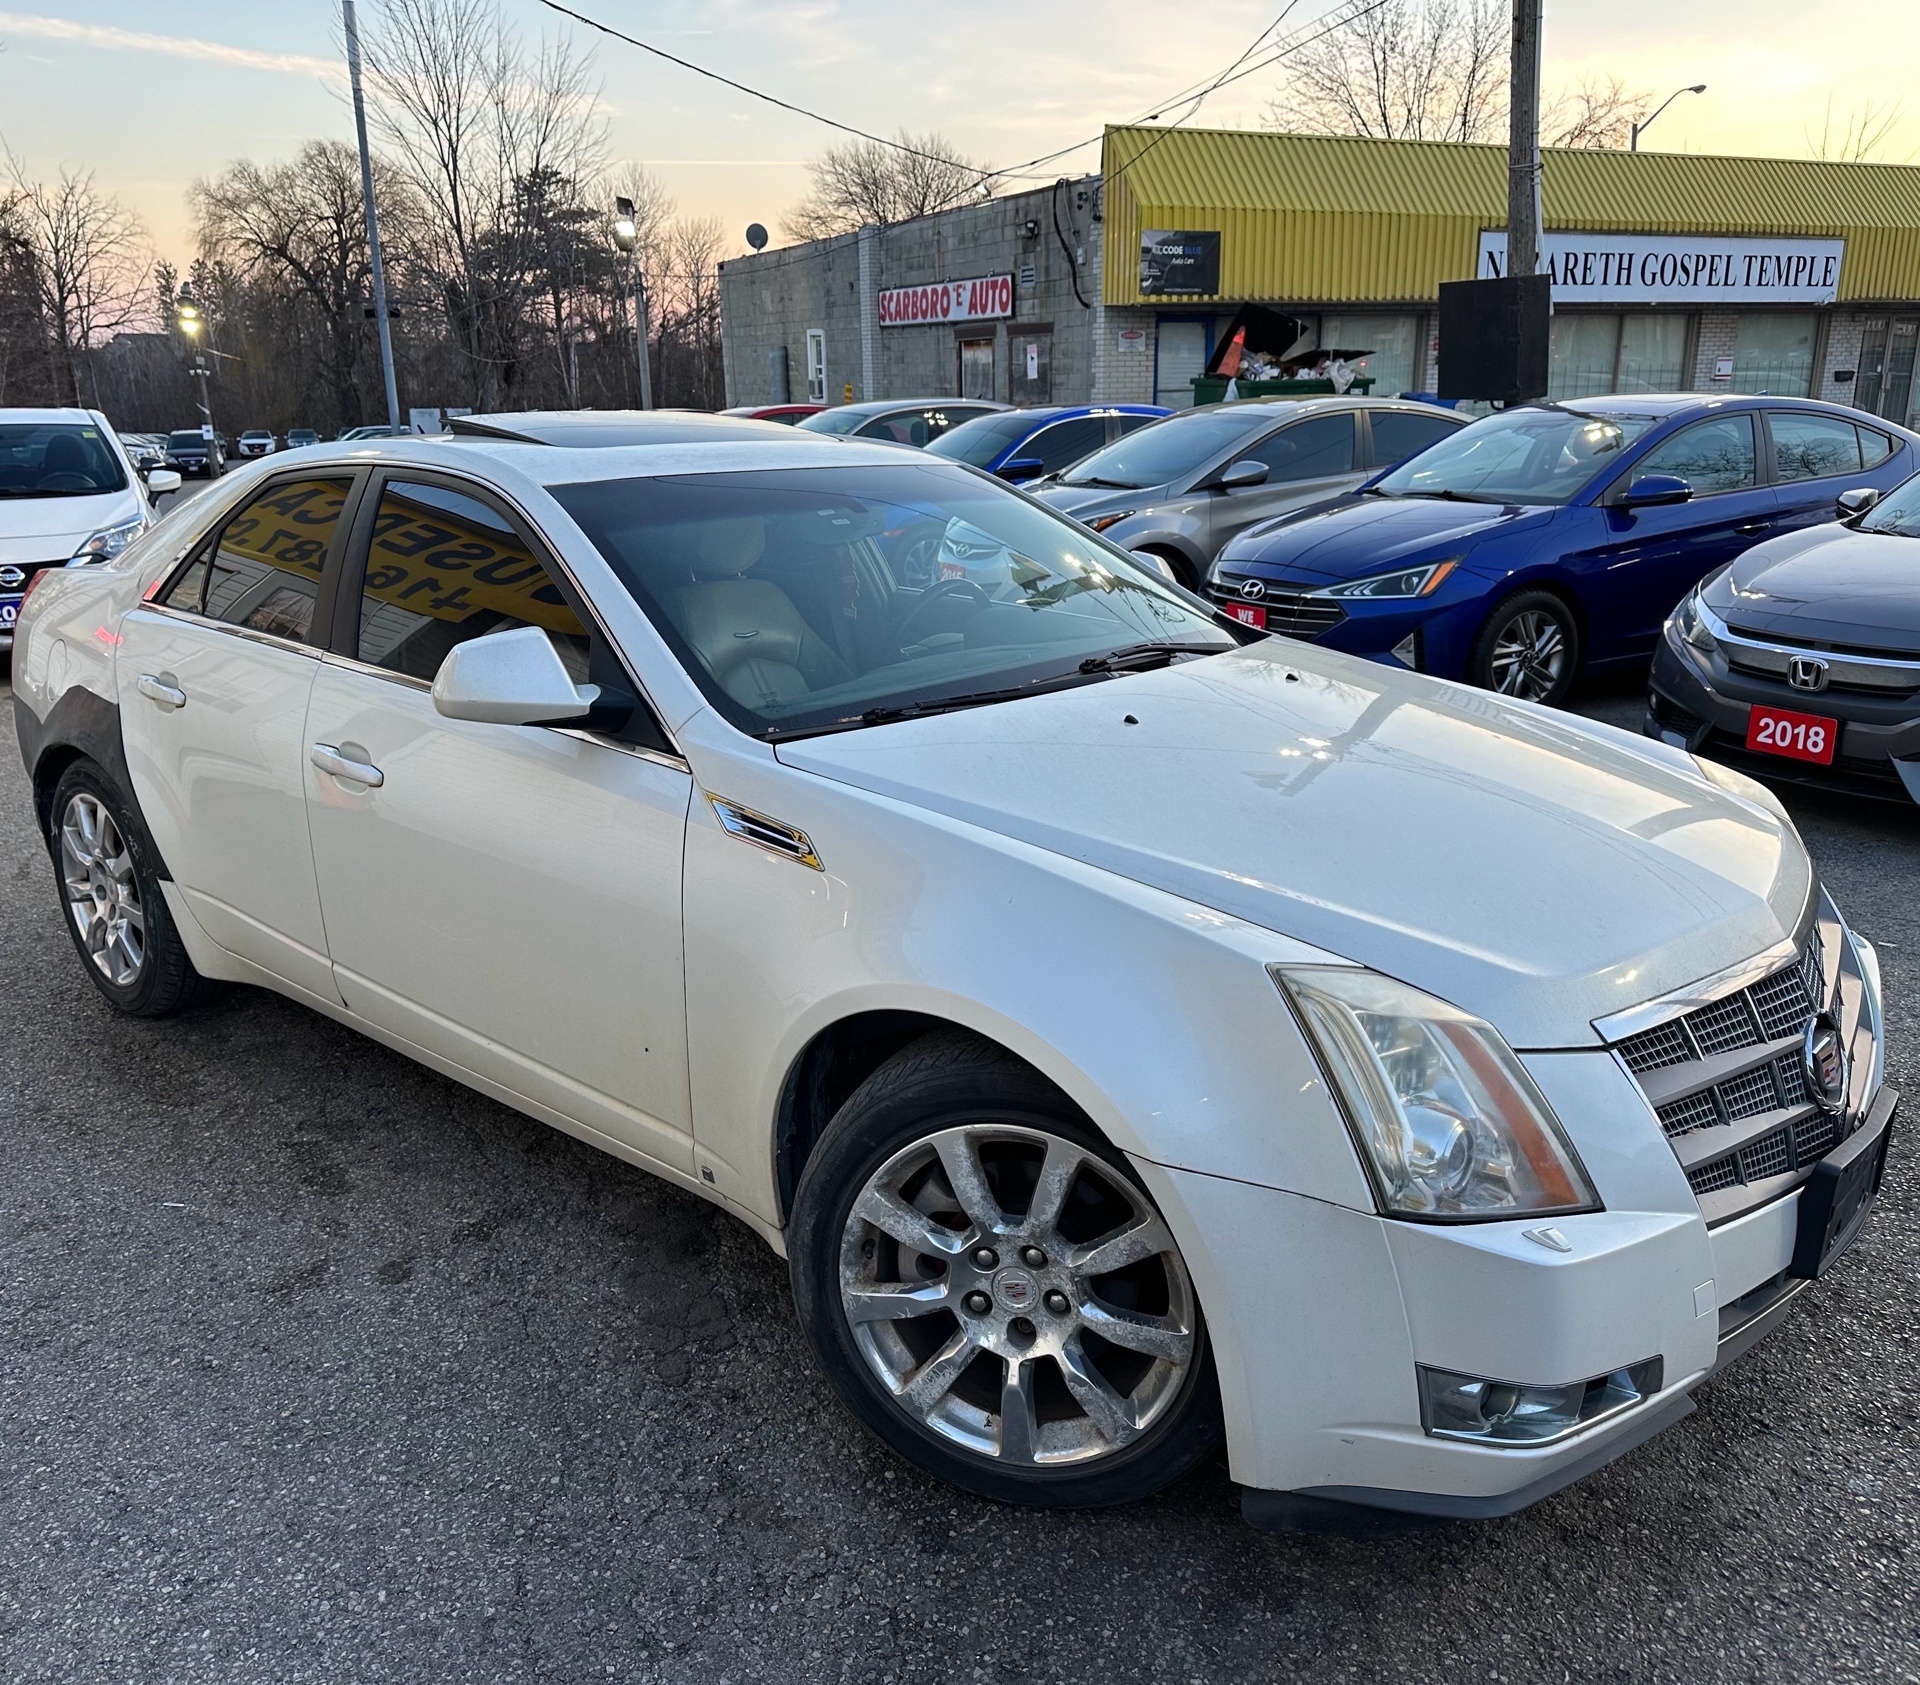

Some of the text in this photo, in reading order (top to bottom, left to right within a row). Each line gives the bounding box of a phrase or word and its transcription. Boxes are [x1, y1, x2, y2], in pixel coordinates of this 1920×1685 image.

[1162, 245, 1184, 255] CODE
[1486, 251, 1837, 288] NARETH GOSPEL TEMPLE
[880, 284, 951, 323] SCARBORO
[968, 277, 1011, 316] AUTO
[1237, 608, 1255, 623] WE
[1756, 716, 1826, 754] 2018
